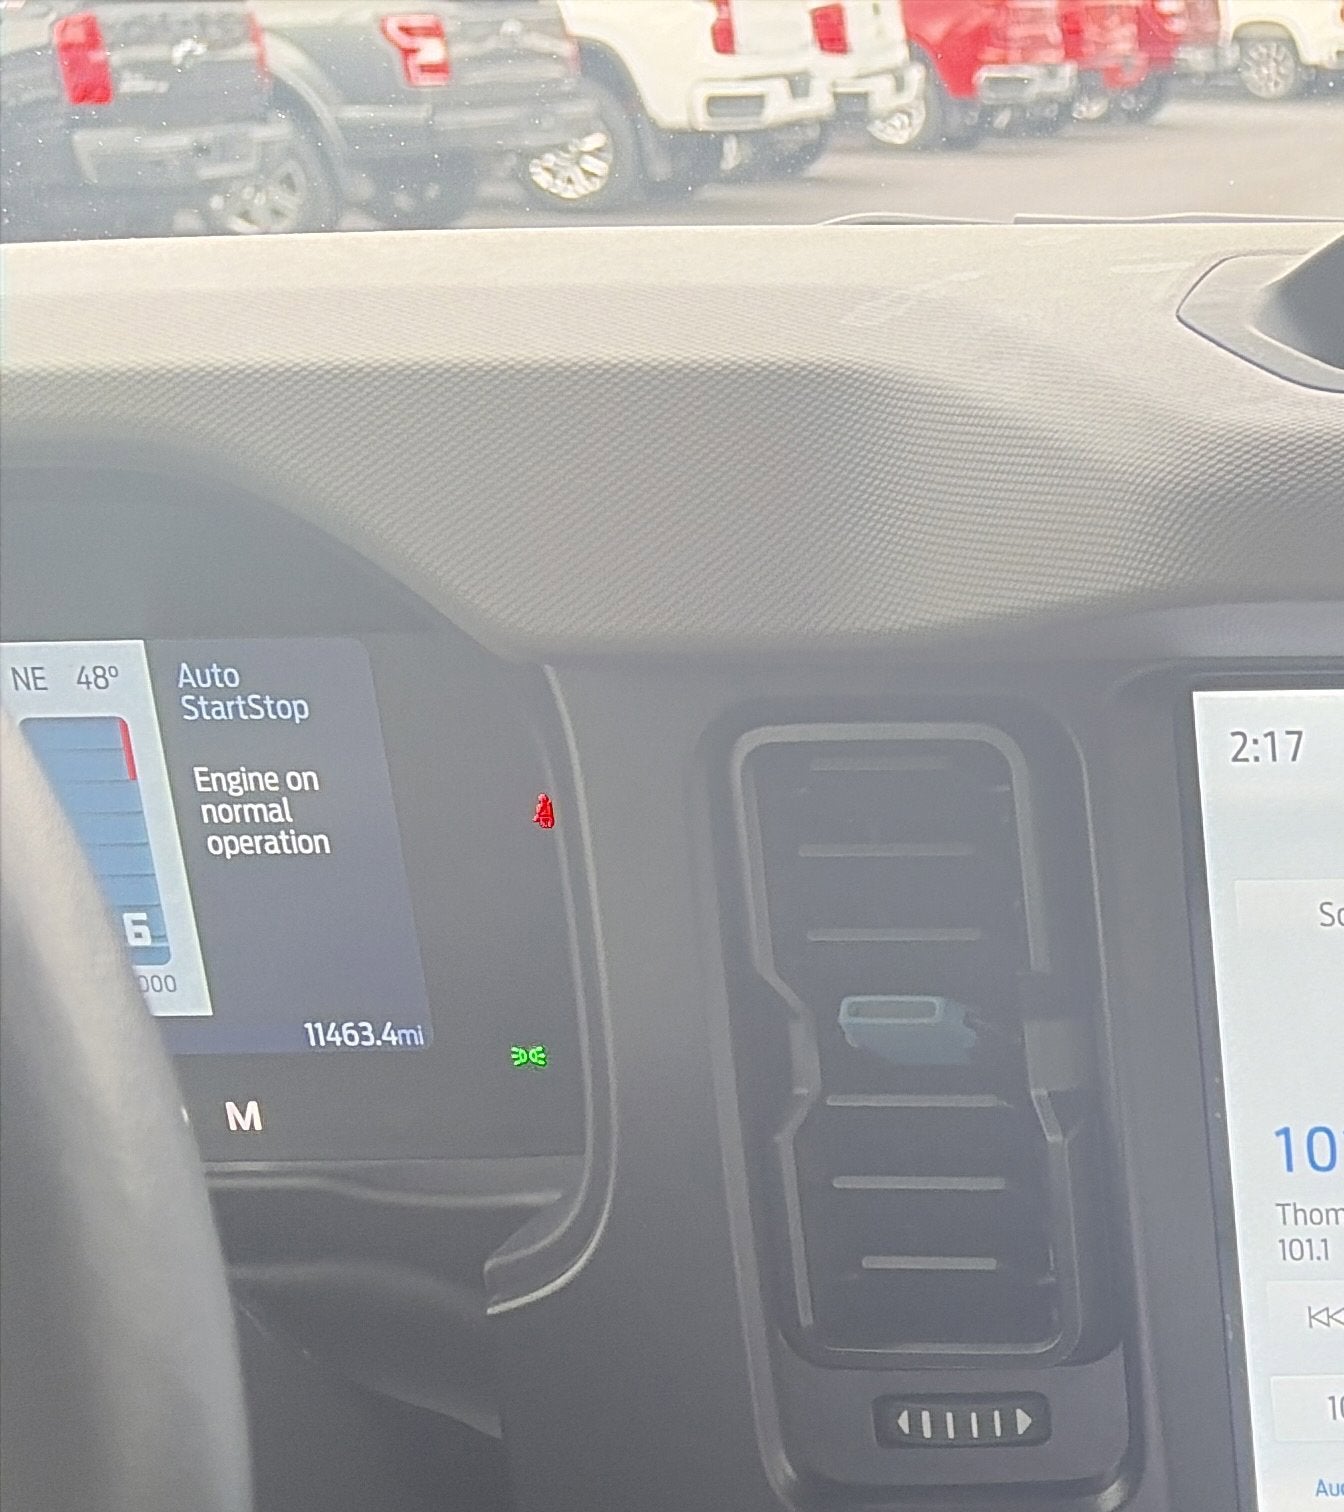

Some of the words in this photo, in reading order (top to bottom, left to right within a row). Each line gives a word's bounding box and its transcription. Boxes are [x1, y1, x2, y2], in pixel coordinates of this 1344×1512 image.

[10, 665, 49, 692] NE
[177, 662, 241, 690] Auto
[182, 694, 311, 724] StartStop
[1229, 729, 1305, 764] 2:17
[192, 765, 281, 797] Engine
[285, 768, 321, 792] on
[200, 796, 294, 825] normal
[206, 827, 331, 859] operation
[123, 912, 152, 946] 6
[303, 1021, 425, 1047] 11463.4mi
[225, 1100, 263, 1131] M
[1277, 1238, 1331, 1262] 101.1
